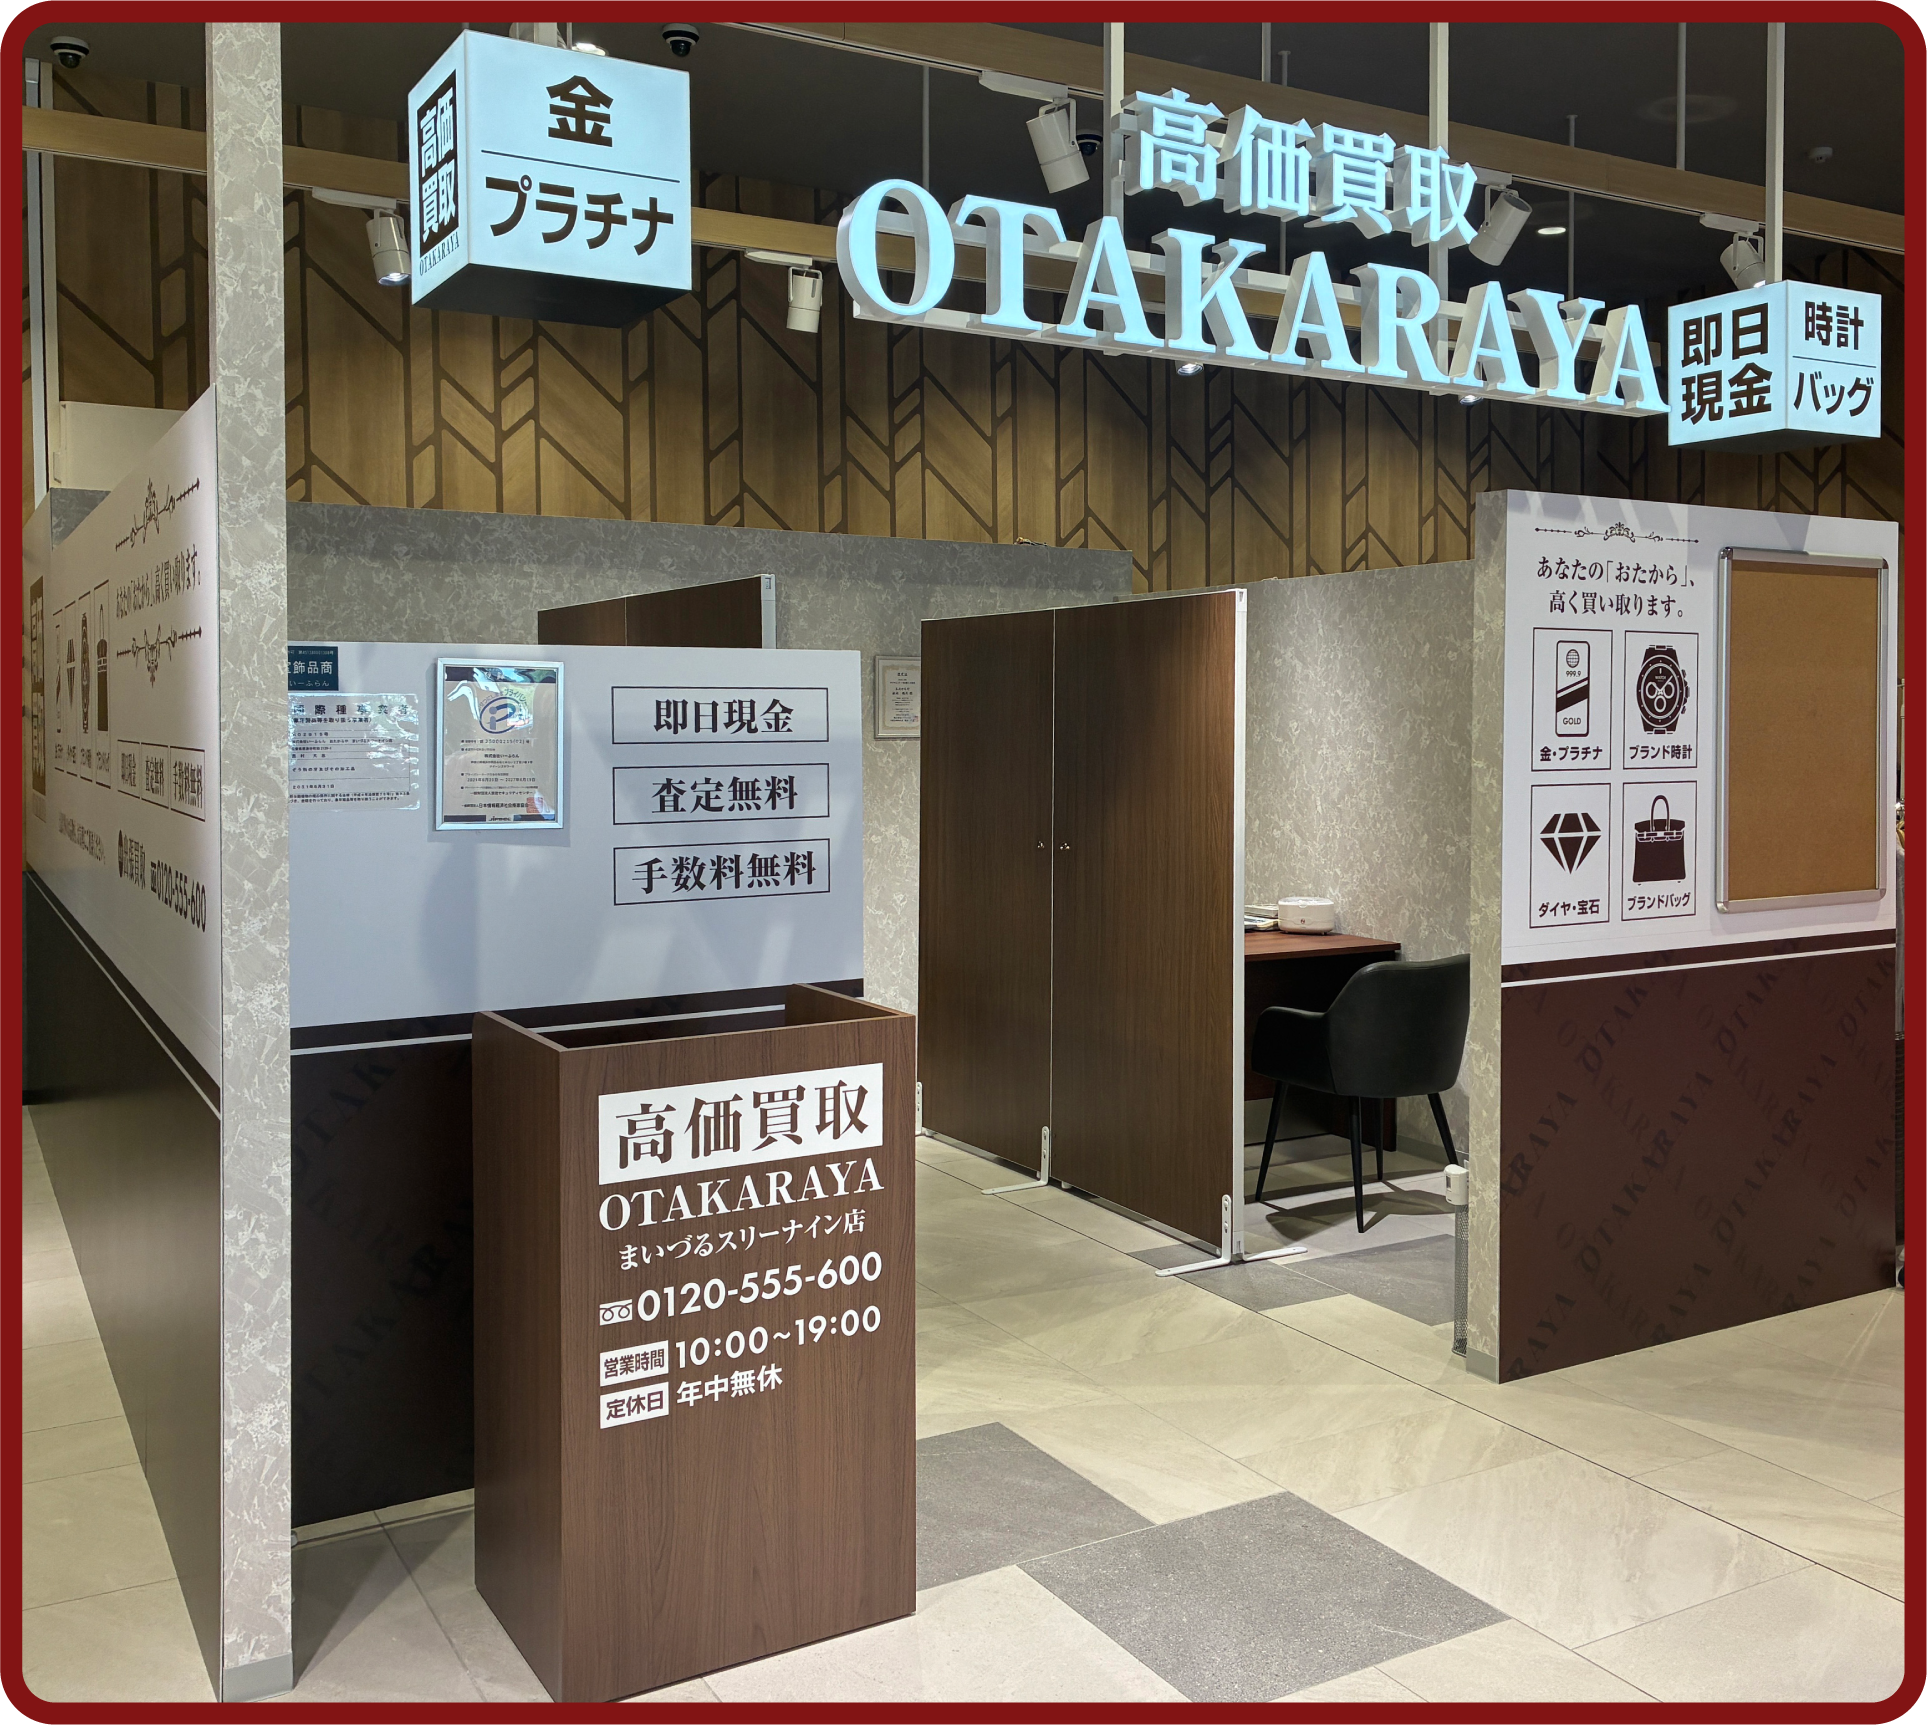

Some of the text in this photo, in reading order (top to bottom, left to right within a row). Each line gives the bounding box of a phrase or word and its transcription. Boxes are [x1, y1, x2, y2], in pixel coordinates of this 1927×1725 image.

[420, 86, 454, 178] 高価
[545, 74, 614, 147] 金
[1130, 87, 1479, 249] 高価買取
[421, 160, 457, 244] 買取
[484, 174, 674, 256] プラチナ
[418, 231, 461, 277] OTAKARAYA
[843, 177, 1673, 414] OTAKARAYA
[1681, 302, 1769, 369] 即日
[1804, 300, 1865, 351] 時計
[1681, 362, 1773, 425] 現金
[1793, 370, 1875, 418] バッグ
[1537, 556, 1695, 588] あなたの「おたから」、
[1548, 590, 1684, 619] 高く買い取ります。
[289, 679, 330, 687] いーふらん
[653, 698, 794, 735] 即日現金
[1562, 717, 1582, 725] GOLD
[1539, 745, 1603, 762] 金・プラチナ
[1629, 744, 1693, 760] ブランド時計
[172, 760, 203, 809] 手数料無料
[651, 775, 799, 814] 査定無料
[157, 860, 207, 933] 0120-555-600
[631, 850, 817, 895] 手数料無料
[1538, 899, 1601, 916] ダイヤ・宝石
[1627, 892, 1691, 912] ブランドバッグ
[615, 1079, 869, 1170] 高価買取
[599, 1157, 885, 1231] OTAKARAYA
[618, 1208, 866, 1271] まいづるスリーナイン店
[636, 1250, 883, 1322] 0120-555-600
[603, 1347, 665, 1379] 営業時間
[605, 1364, 783, 1421] 定休日 年中無休
